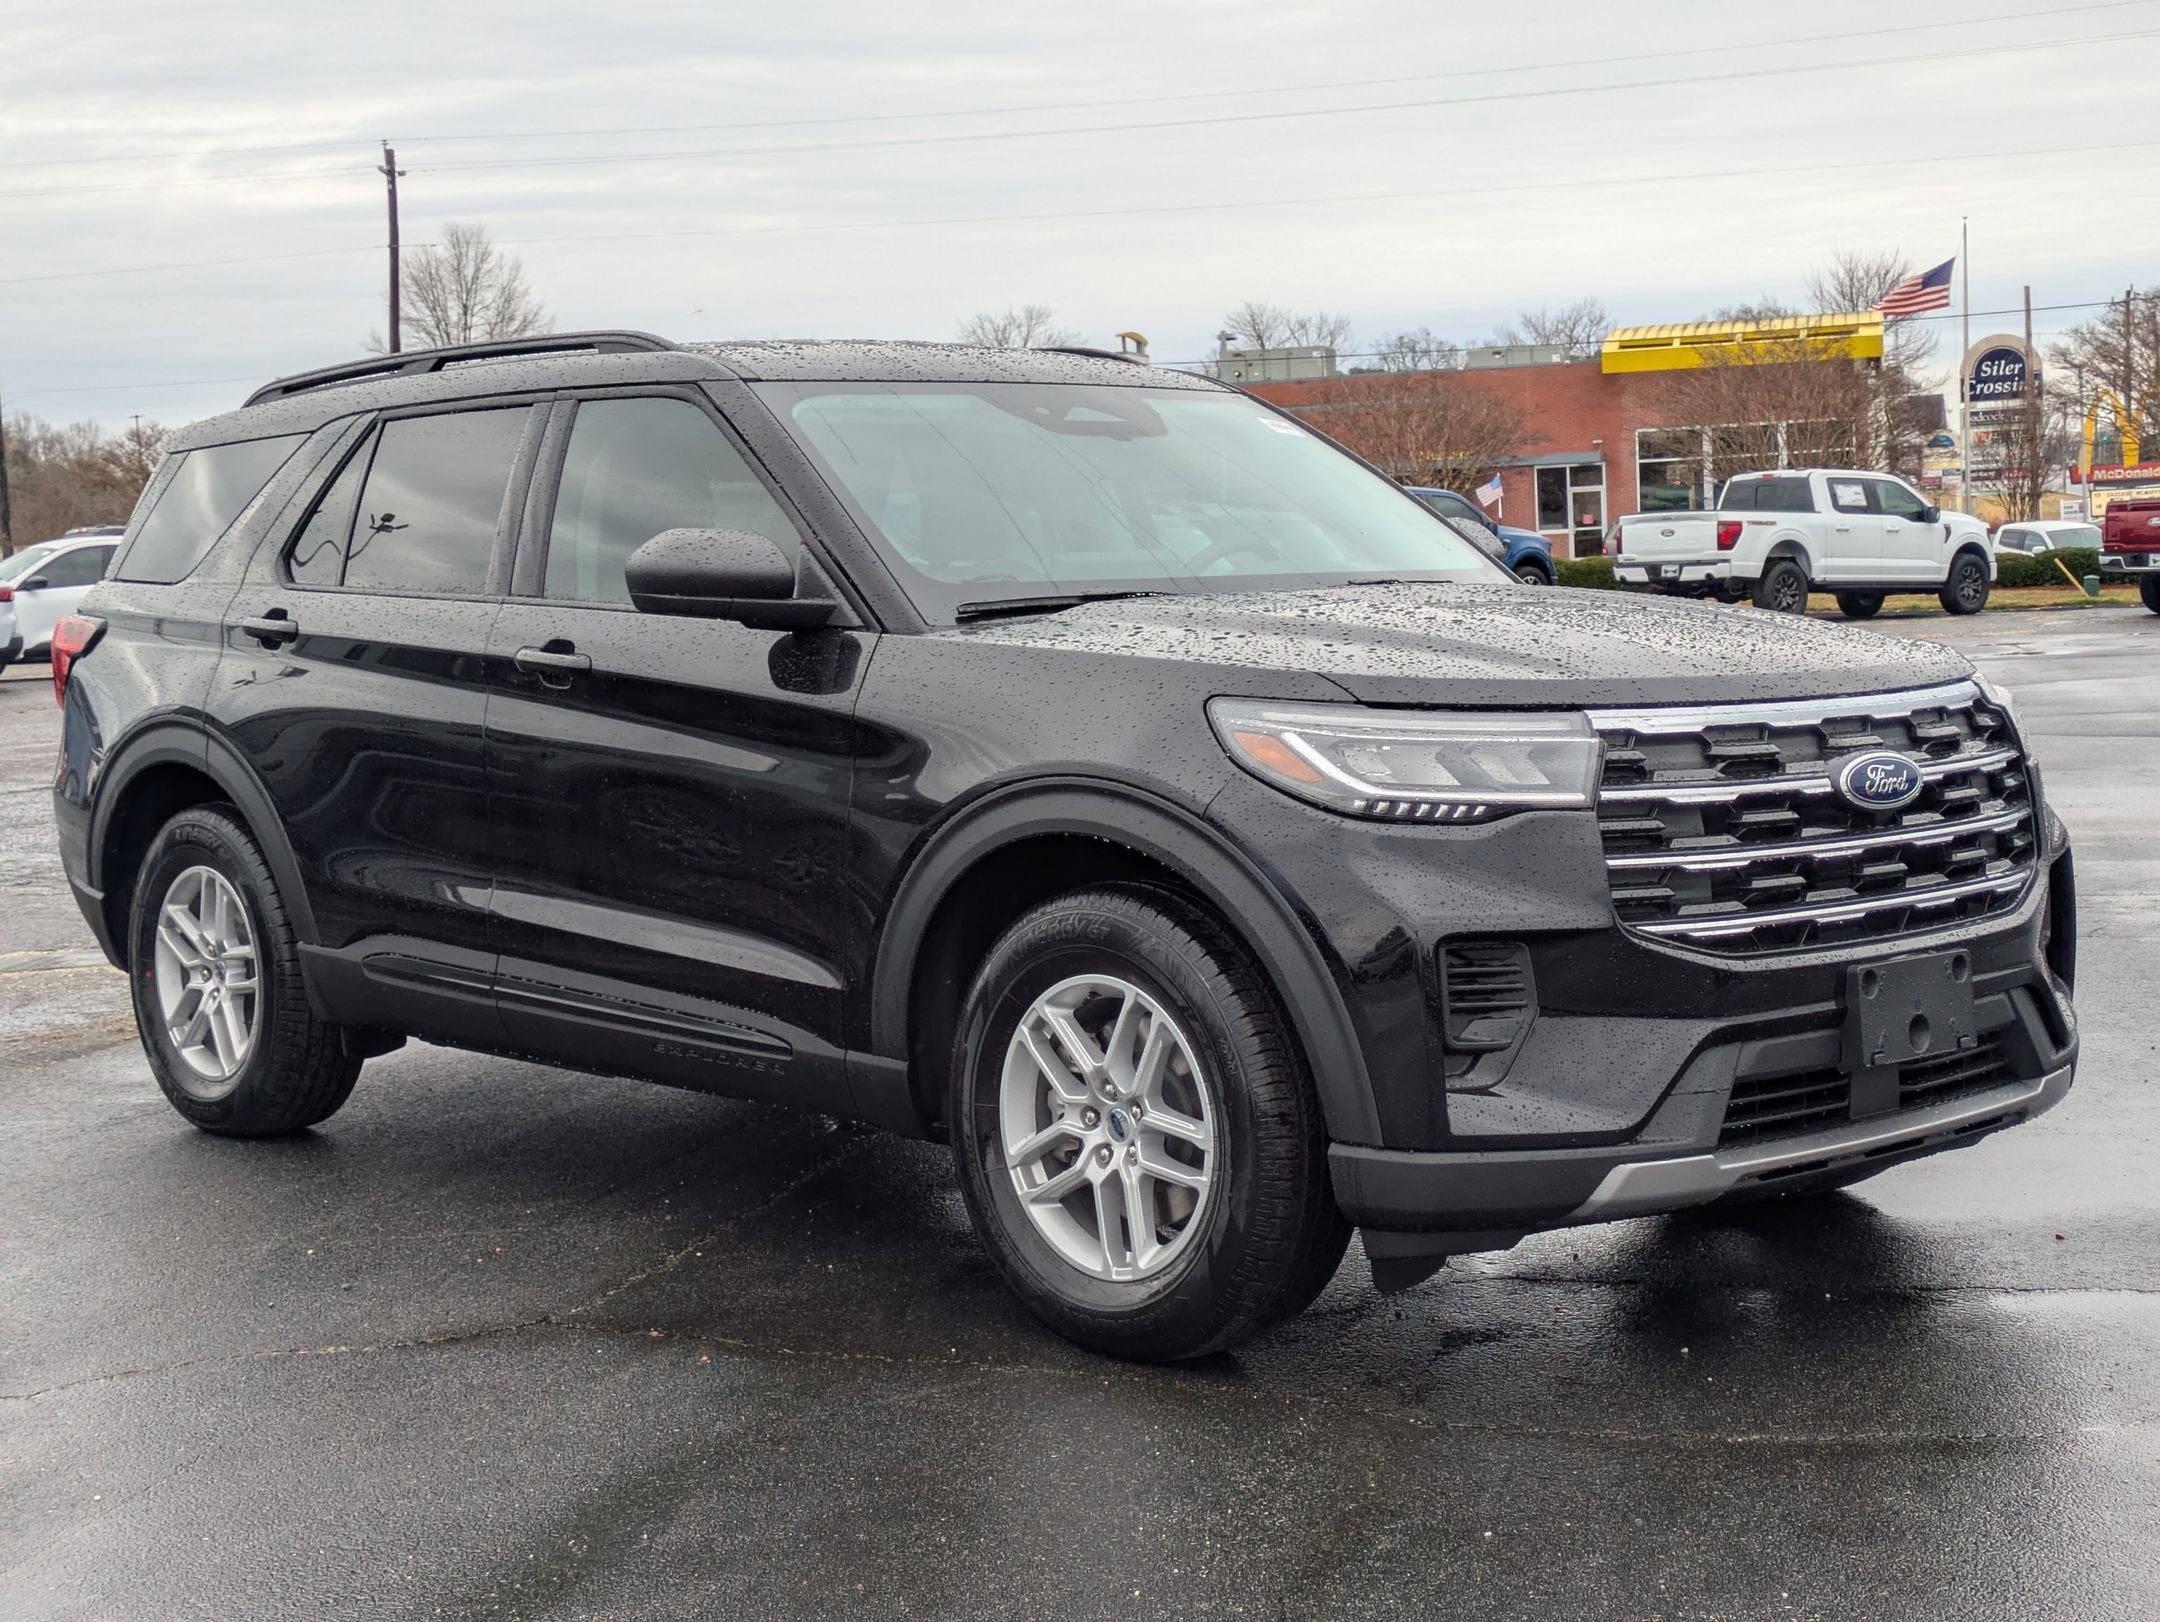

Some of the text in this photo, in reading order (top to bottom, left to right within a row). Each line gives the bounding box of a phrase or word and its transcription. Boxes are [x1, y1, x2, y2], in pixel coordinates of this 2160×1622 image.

[1980, 360, 2023, 377] Siler
[1963, 377, 2039, 396] Crossi
[1865, 764, 1909, 797] Ford
[651, 1041, 785, 1076] EXPLORER
